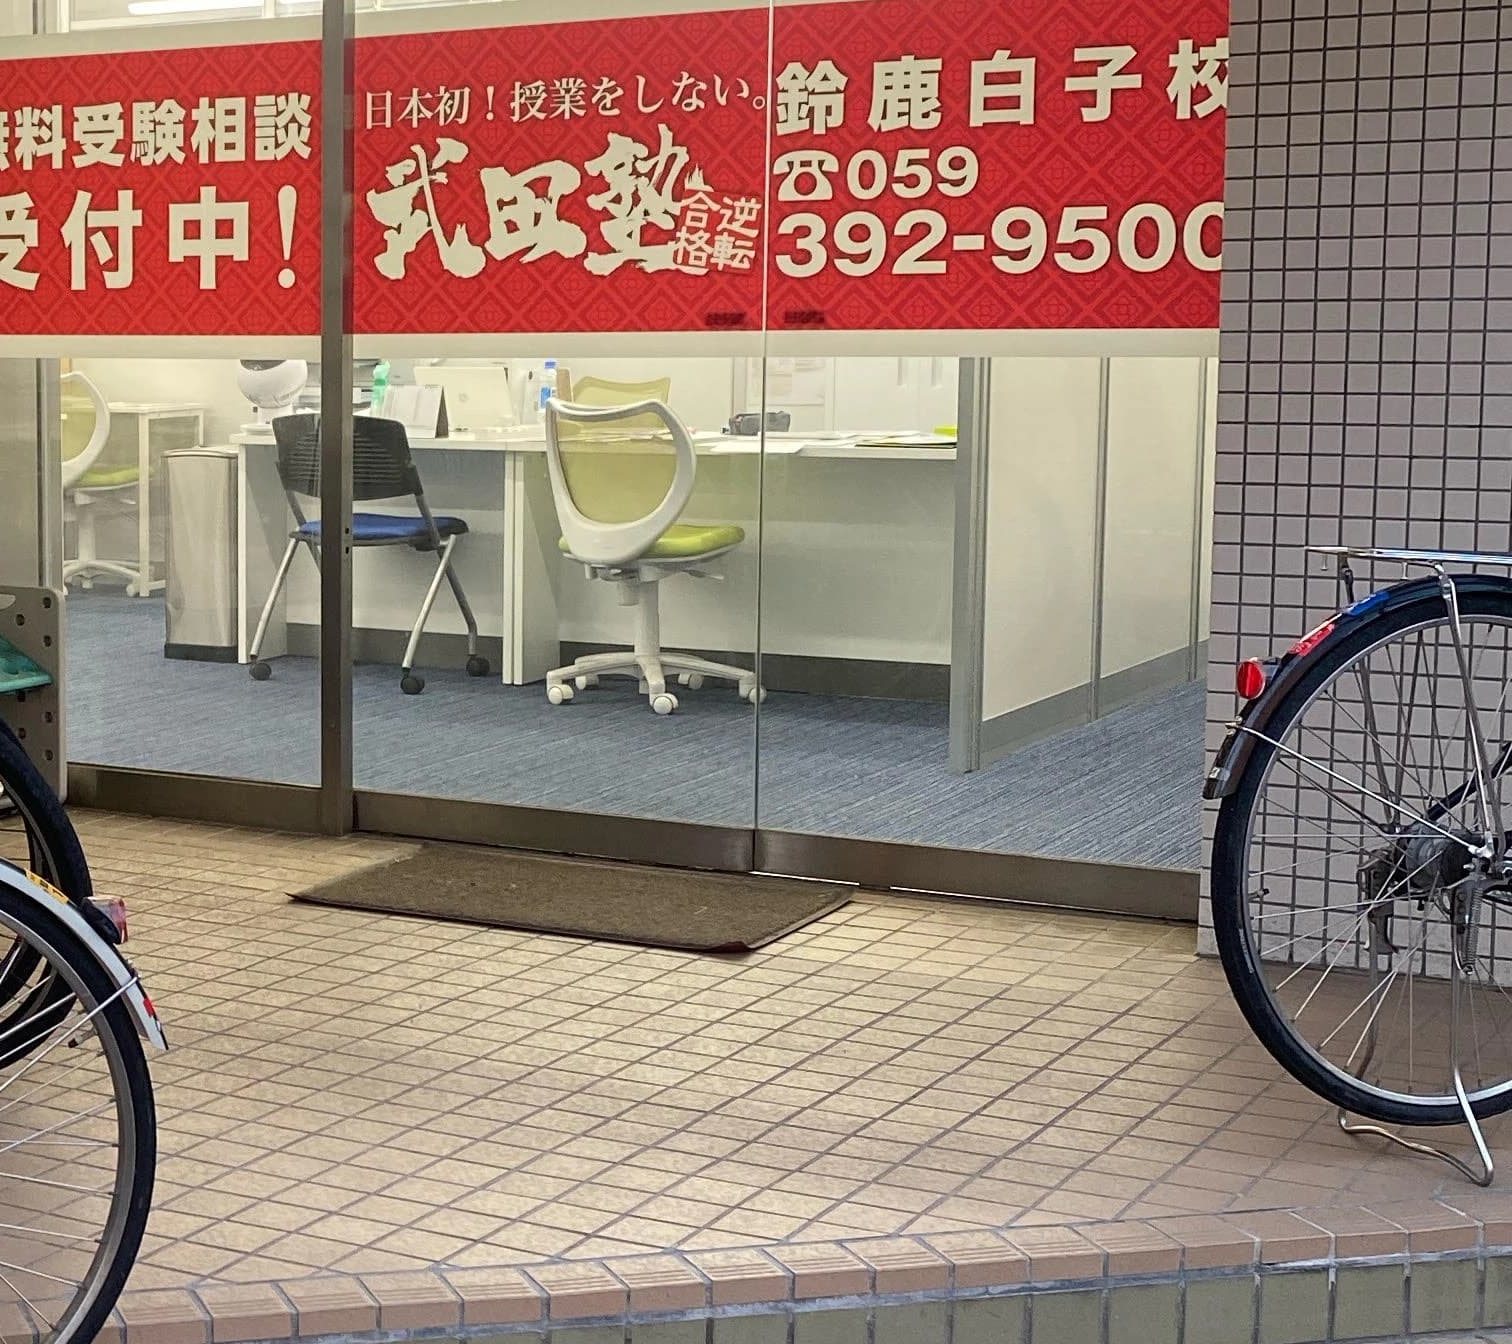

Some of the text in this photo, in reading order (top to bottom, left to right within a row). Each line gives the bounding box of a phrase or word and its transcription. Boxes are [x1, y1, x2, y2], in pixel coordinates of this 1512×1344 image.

[364, 70, 769, 130] 日本初！授業をしない。
[774, 36, 1229, 136] 鈴鹿白子校
[367, 122, 714, 281] 武田塾
[847, 146, 980, 200] 059
[774, 200, 1226, 277] 392-9500
